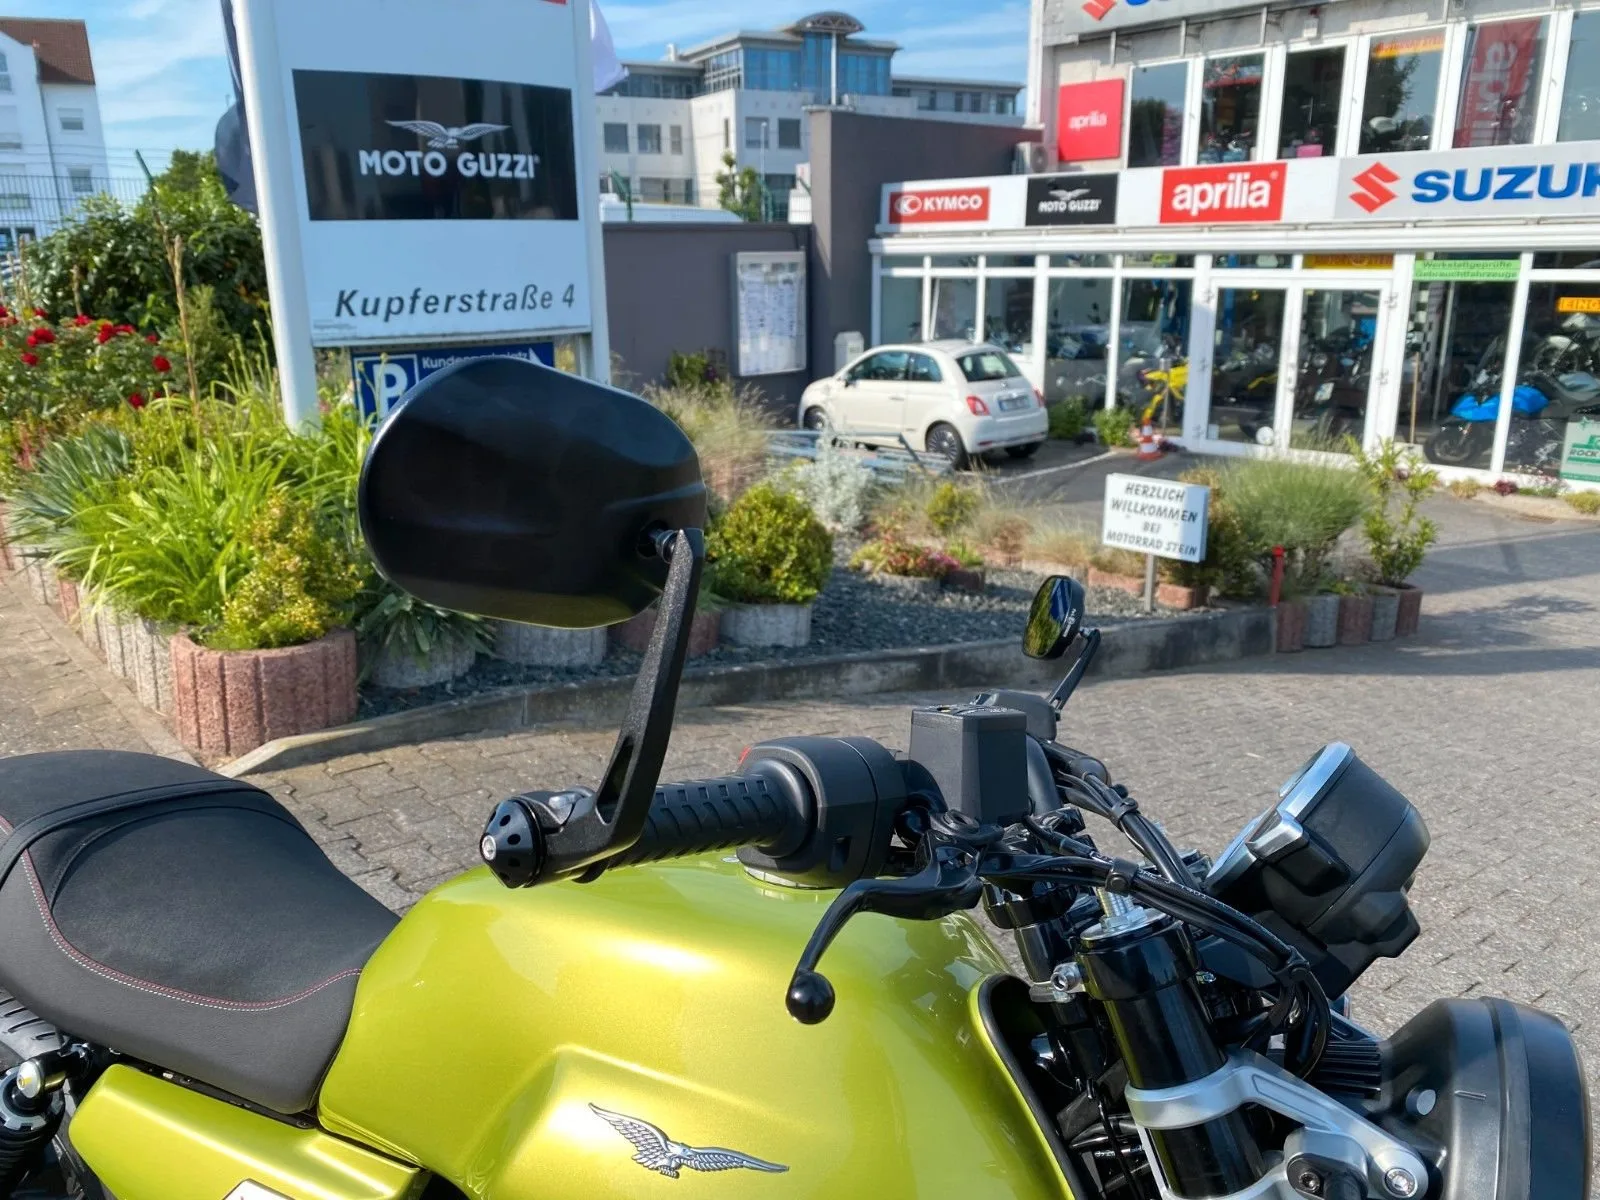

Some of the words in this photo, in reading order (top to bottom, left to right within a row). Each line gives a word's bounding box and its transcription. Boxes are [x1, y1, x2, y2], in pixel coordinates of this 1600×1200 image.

[1068, 110, 1108, 131] aprilia
[359, 149, 447, 176] MOTO
[456, 151, 536, 179] GUZZI
[923, 193, 983, 212] KYMCO
[1171, 171, 1272, 217] aprilia
[1038, 200, 1067, 213] MOTO
[334, 283, 554, 323] Kupferstraße
[561, 283, 576, 309] 4
[1125, 482, 1185, 502] HERZLICH
[1111, 499, 1199, 523] WILLKOMMEN
[1142, 521, 1162, 534] BEI
[1106, 529, 1163, 550] MOTORRAD
[1165, 542, 1197, 556] STEIN
